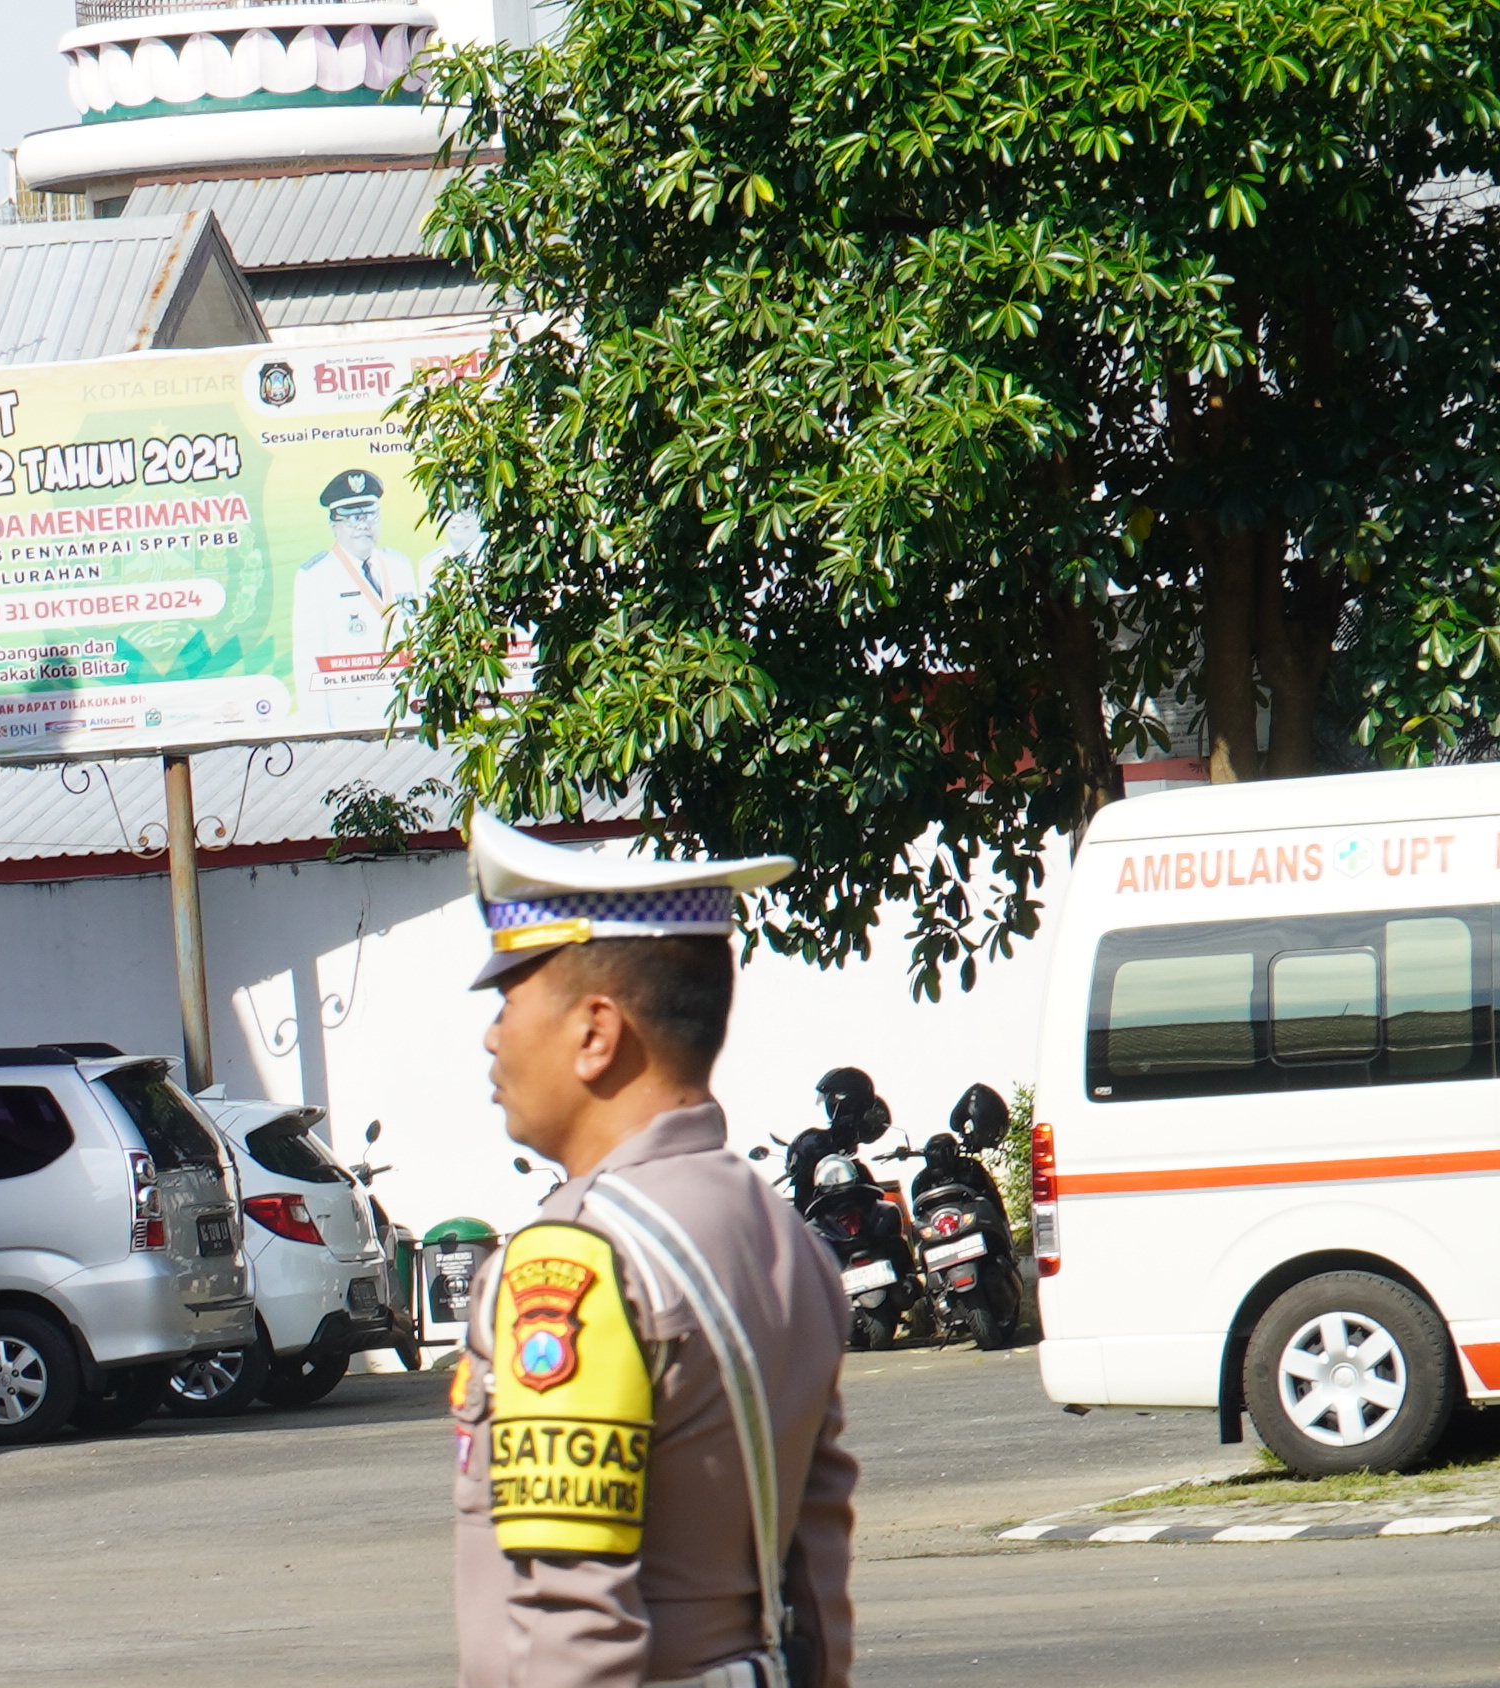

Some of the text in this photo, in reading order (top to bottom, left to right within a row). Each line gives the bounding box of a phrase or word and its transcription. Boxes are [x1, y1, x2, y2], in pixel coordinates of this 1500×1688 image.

[83, 375, 236, 401] KOTA BLITAR
[261, 431, 308, 444] Sesuai
[312, 424, 382, 440] Peraturan
[19, 438, 137, 494] TAHUN
[143, 433, 242, 486] 2024
[30, 497, 249, 537] MENERIMANYA
[12, 540, 131, 560] PENYAMPAI
[140, 535, 191, 551] SPPT
[200, 531, 239, 546] PBB
[6, 603, 29, 621] 31
[34, 595, 140, 619] OKTOBER
[146, 590, 202, 610] 2024
[84, 639, 115, 654] dan
[40, 663, 78, 678] Kota
[82, 659, 128, 676] Blitar
[19, 701, 56, 714] DAPAT
[60, 696, 127, 711] DILAKUKAN
[10, 723, 37, 737] BNI
[1115, 843, 1324, 894] AMBULANS
[1382, 835, 1456, 877] UPT
